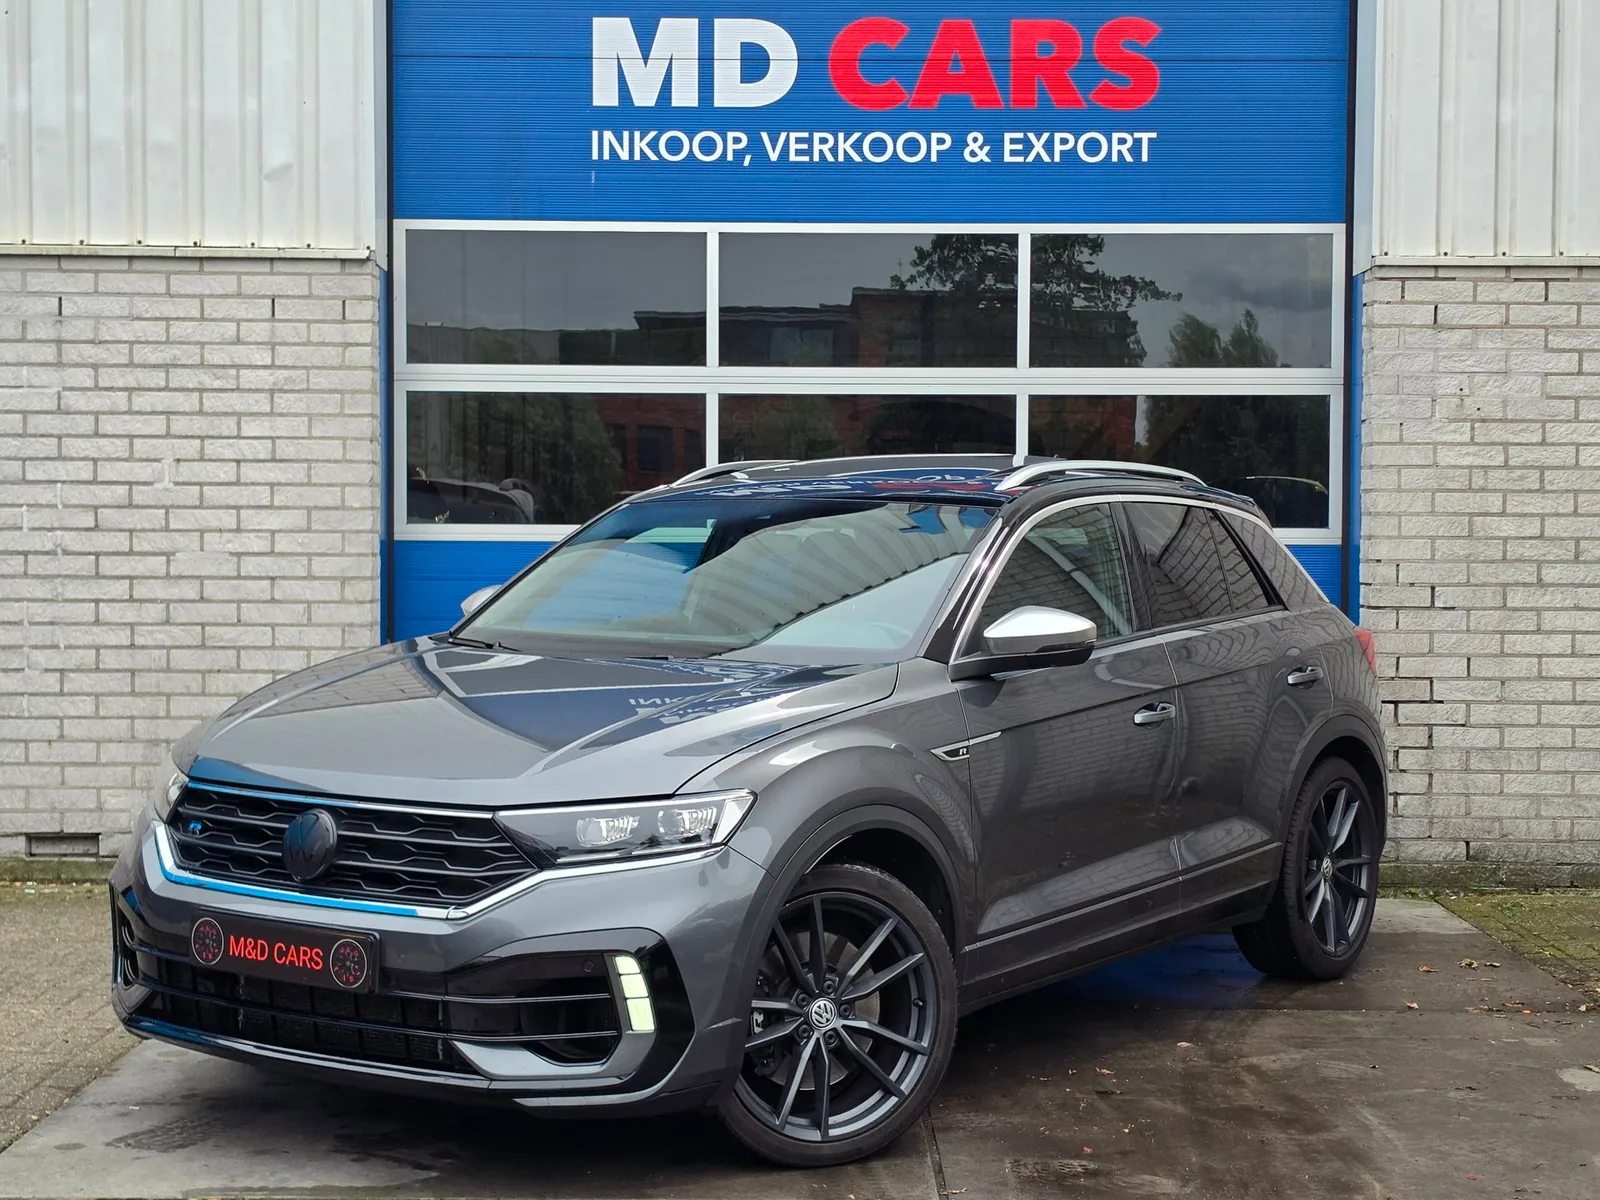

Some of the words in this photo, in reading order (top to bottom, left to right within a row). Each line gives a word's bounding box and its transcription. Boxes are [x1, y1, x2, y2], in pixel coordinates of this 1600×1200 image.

[592, 17, 798, 107] MD
[828, 16, 1161, 110] CARS
[591, 130, 751, 166] INKOOP,
[760, 132, 952, 163] VERKOOP
[963, 132, 991, 163] &
[1003, 132, 1157, 163] EXPORT
[229, 935, 269, 962] M&D
[273, 942, 324, 970] CARS
